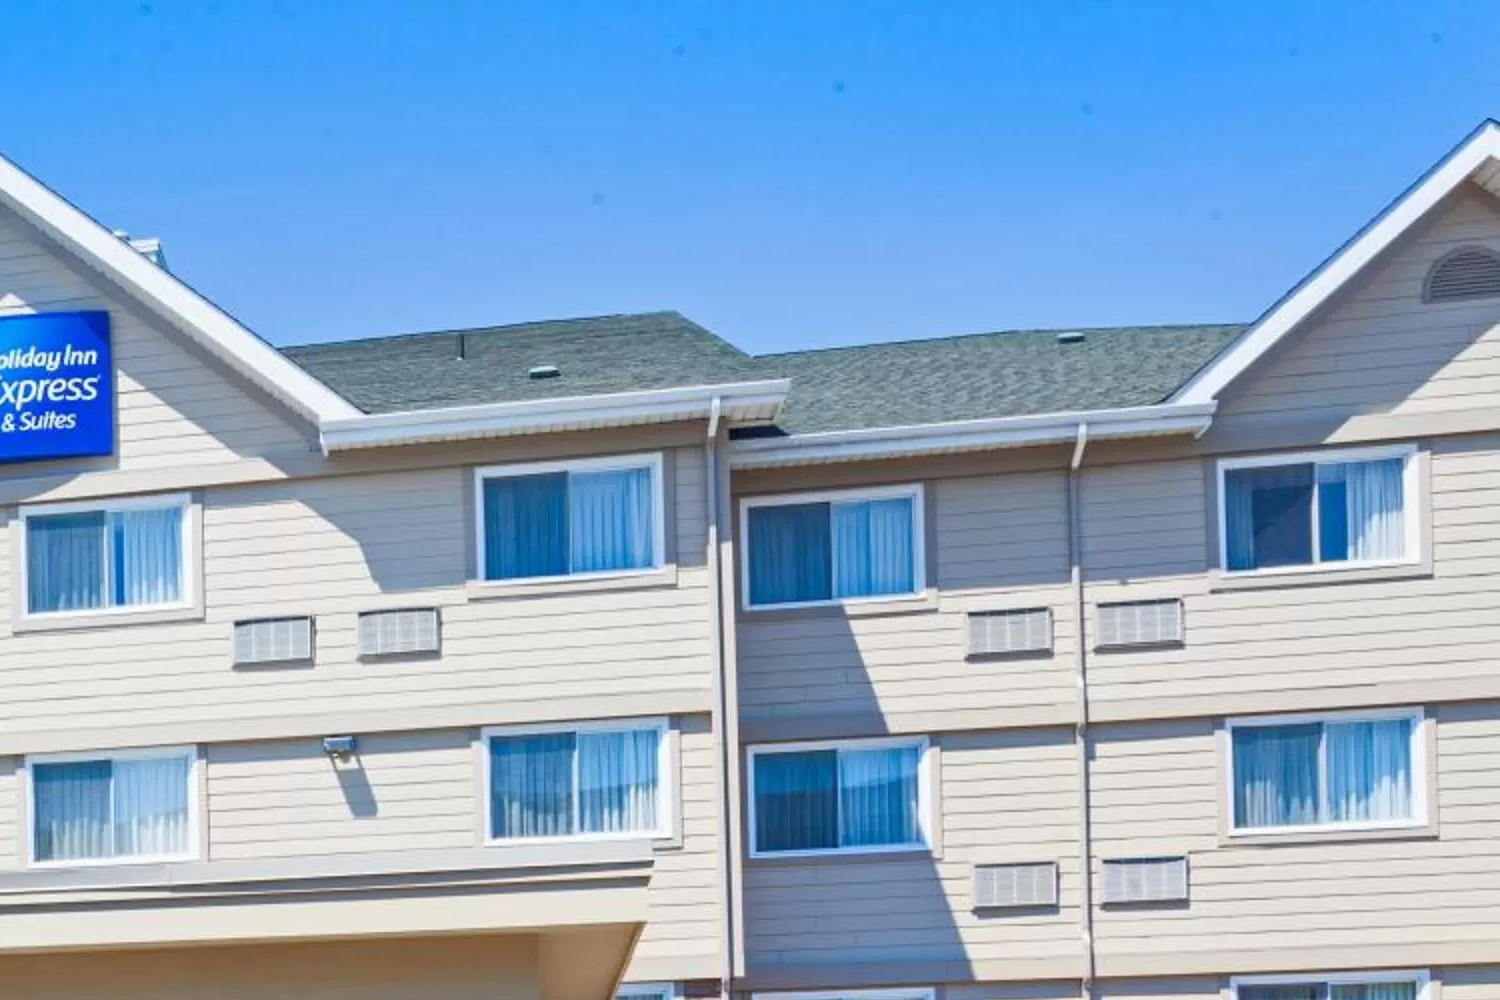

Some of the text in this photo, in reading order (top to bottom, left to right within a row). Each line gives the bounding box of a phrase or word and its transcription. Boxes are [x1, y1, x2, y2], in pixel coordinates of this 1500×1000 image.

[63, 344, 97, 366] Inn
[1, 411, 76, 433] & Suites
